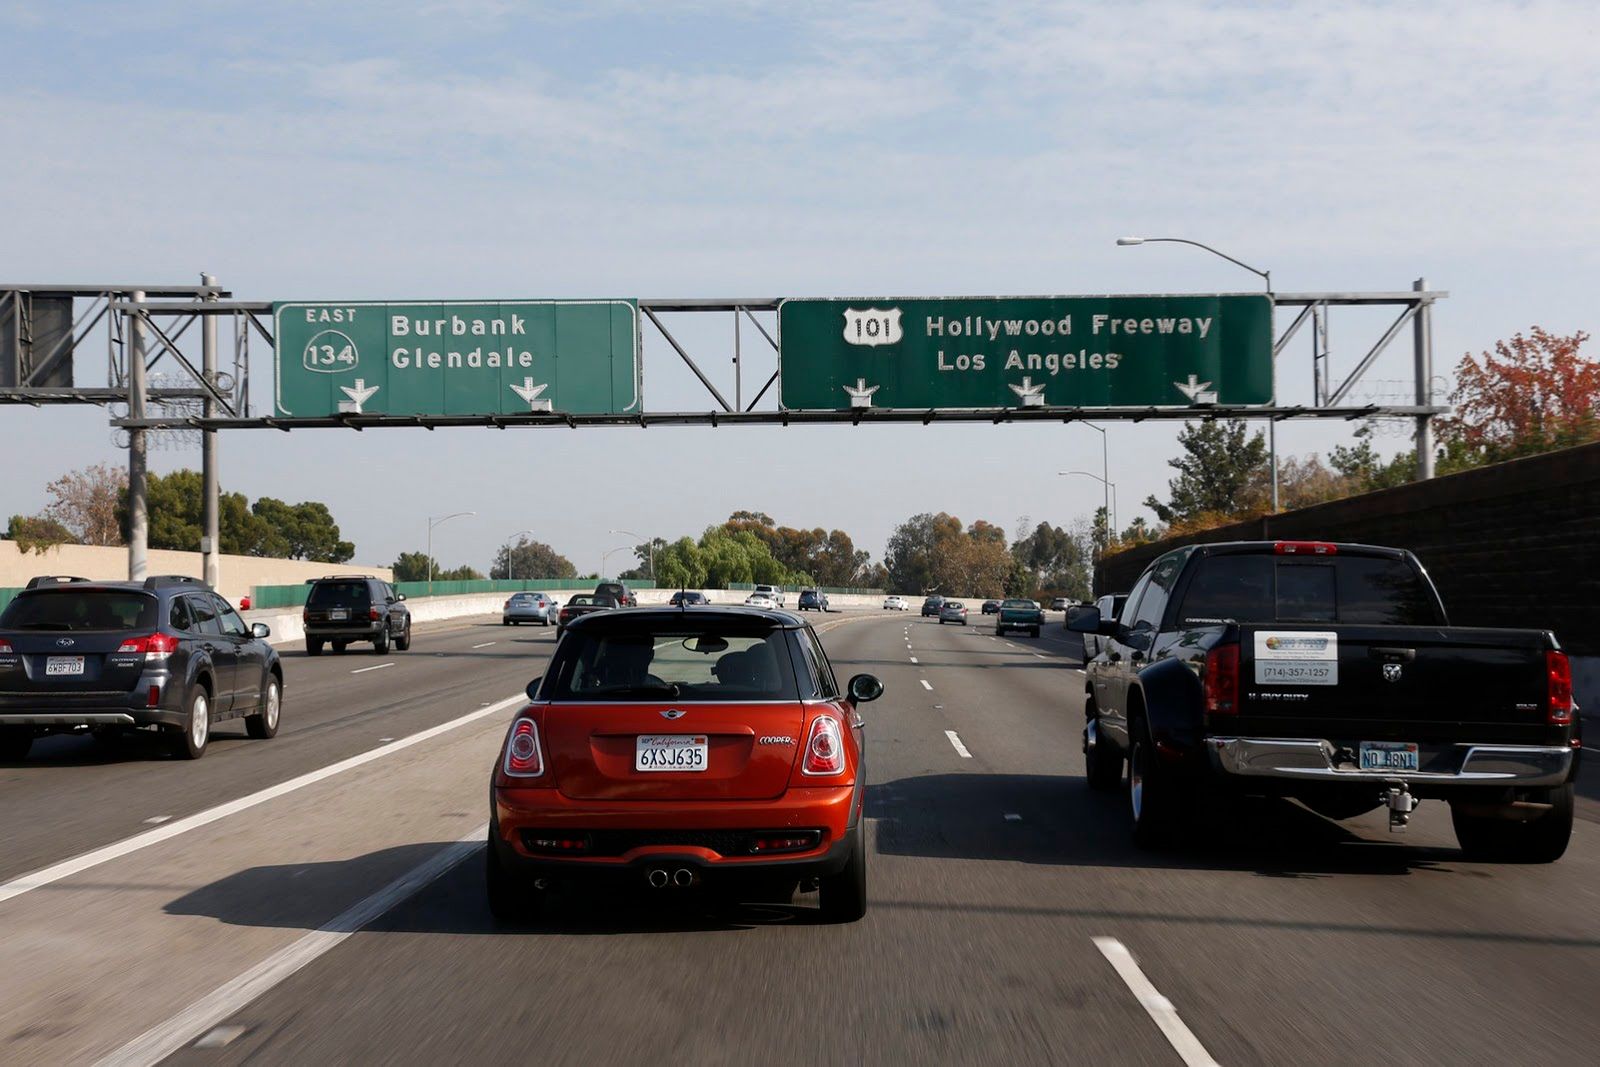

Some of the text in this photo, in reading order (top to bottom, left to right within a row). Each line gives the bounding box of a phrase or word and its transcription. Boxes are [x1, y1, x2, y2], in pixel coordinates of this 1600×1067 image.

[305, 309, 356, 323] EAST
[391, 314, 527, 337] Burbank
[854, 317, 891, 339] 101
[926, 314, 1213, 341] Hollywood Freeway
[308, 345, 355, 365] 134
[391, 347, 533, 369] Glendale
[937, 349, 1121, 376] Los Angeles
[1264, 668, 1329, 677] (714)-357-1257
[651, 738, 691, 747] California
[759, 736, 791, 744] COOPER
[641, 748, 702, 766] 6XSJ635
